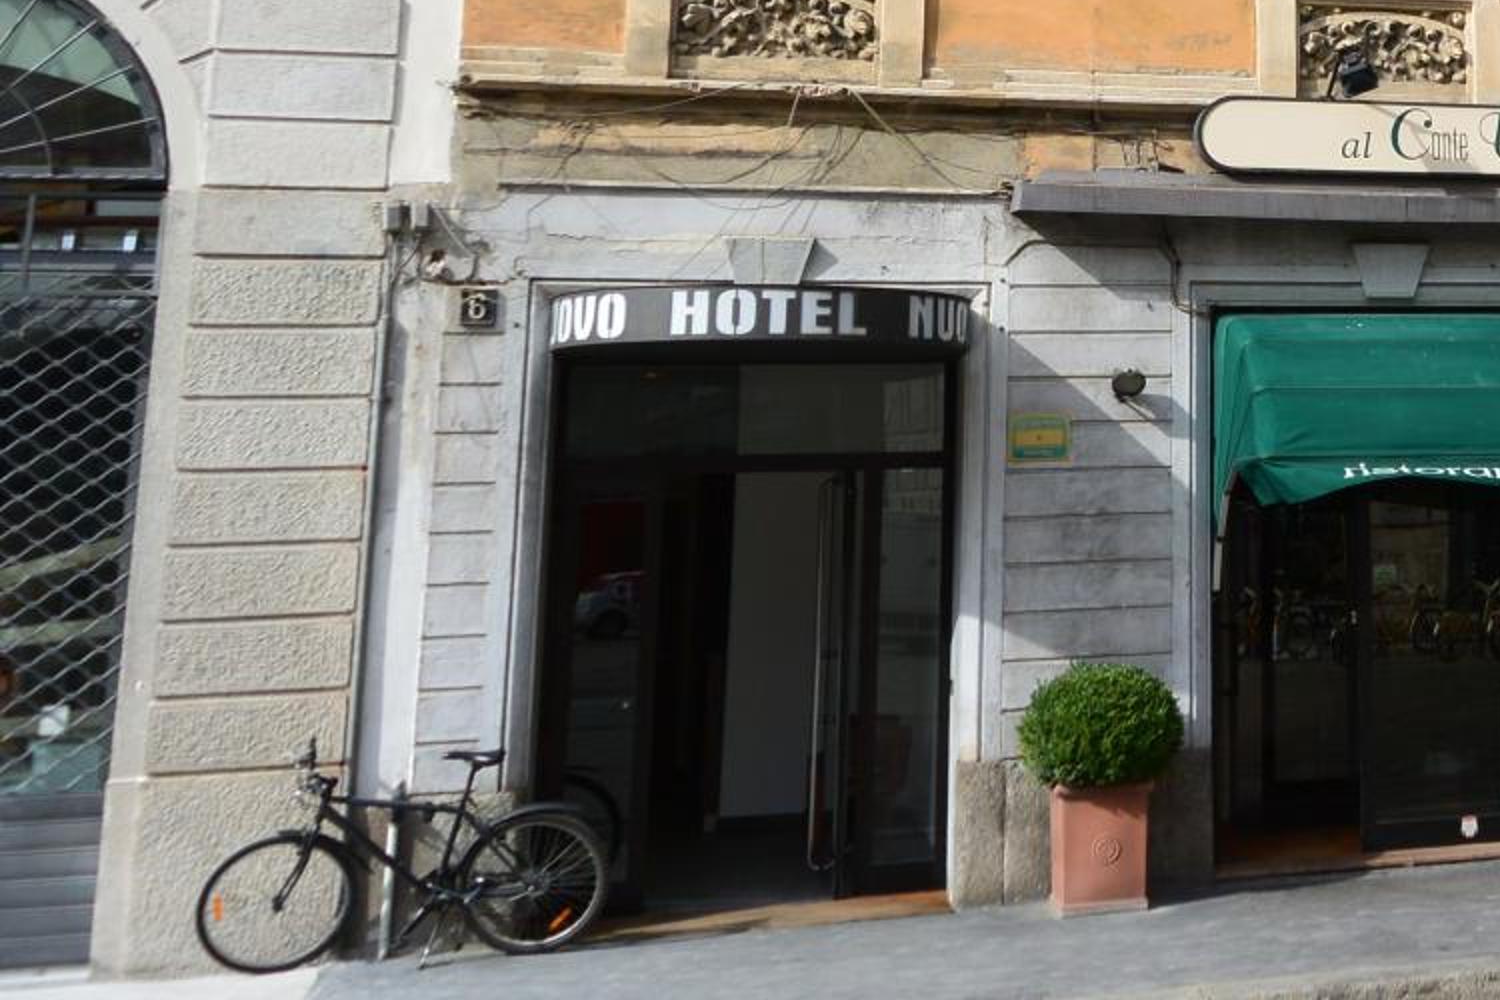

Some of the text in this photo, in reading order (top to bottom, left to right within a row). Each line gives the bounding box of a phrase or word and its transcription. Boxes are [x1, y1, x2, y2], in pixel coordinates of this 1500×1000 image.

[1341, 131, 1372, 159] al
[1391, 107, 1469, 161] Conte
[670, 288, 867, 336] HOTEL
